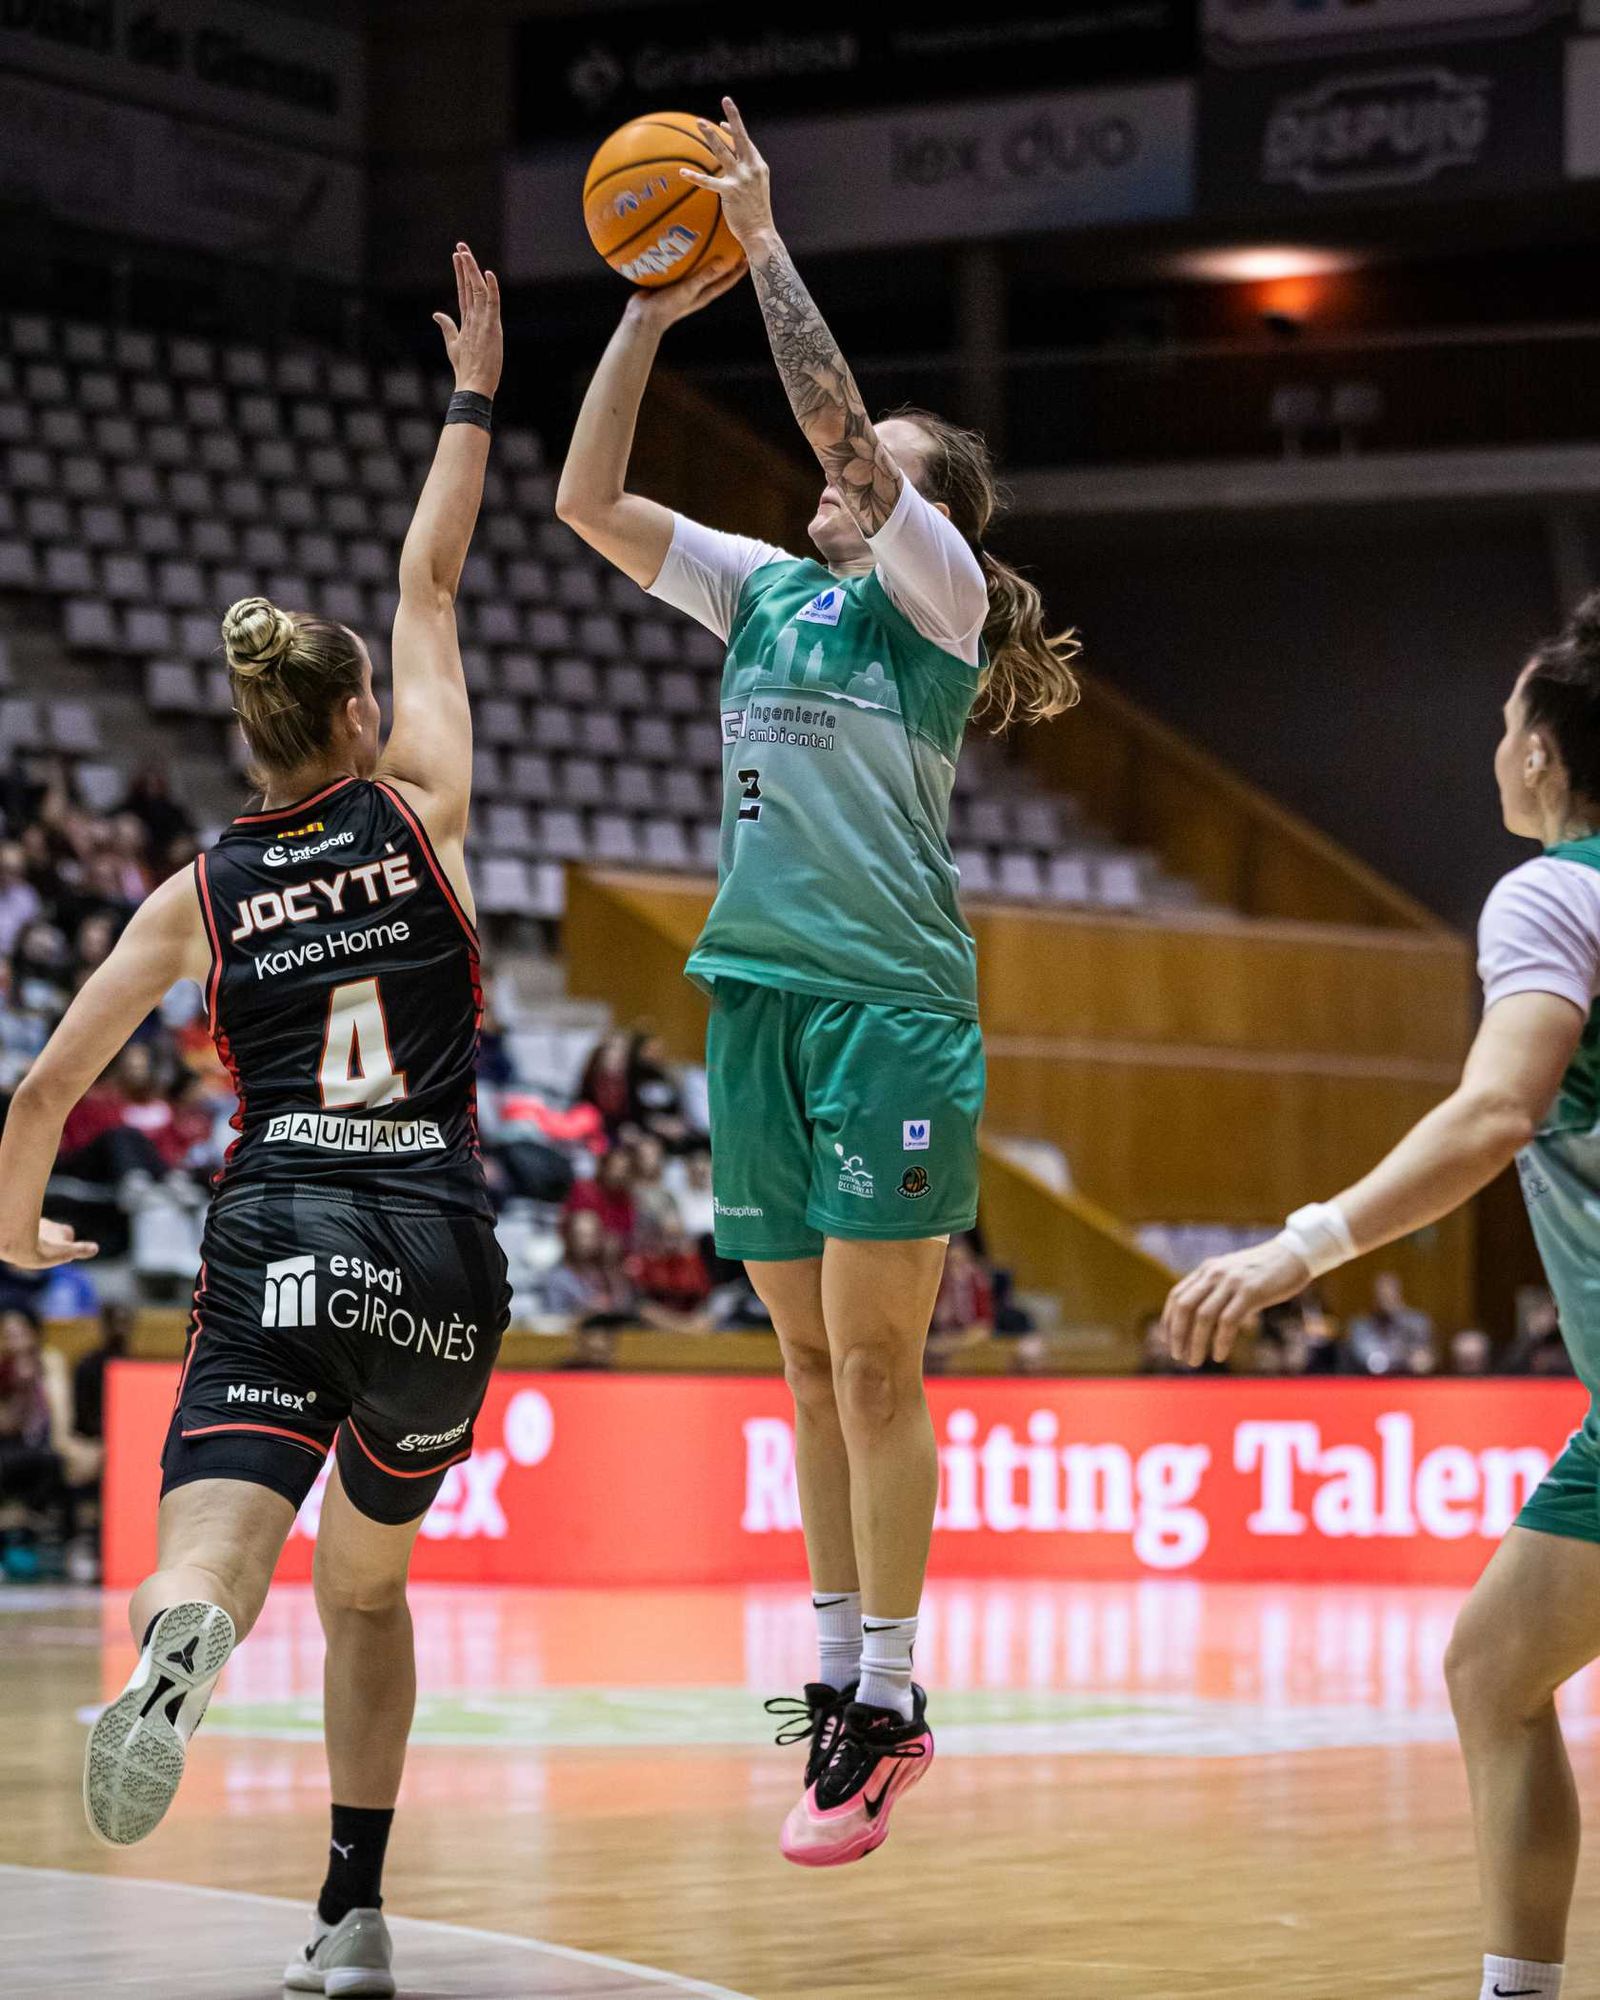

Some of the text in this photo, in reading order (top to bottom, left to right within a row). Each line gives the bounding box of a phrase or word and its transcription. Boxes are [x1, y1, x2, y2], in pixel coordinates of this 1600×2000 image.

[748, 727, 834, 751] ambiental
[736, 768, 763, 823] 2
[253, 920, 411, 980] Kave Home
[316, 976, 409, 1110] 4
[266, 1113, 445, 1151] BAUHAUS
[719, 1205, 763, 1218] Hospiten
[329, 1254, 403, 1296] espai
[327, 1289, 478, 1363] GIRONÈS
[396, 1417, 470, 1451] ginvest
[741, 1409, 1572, 1569] Riting Talen
